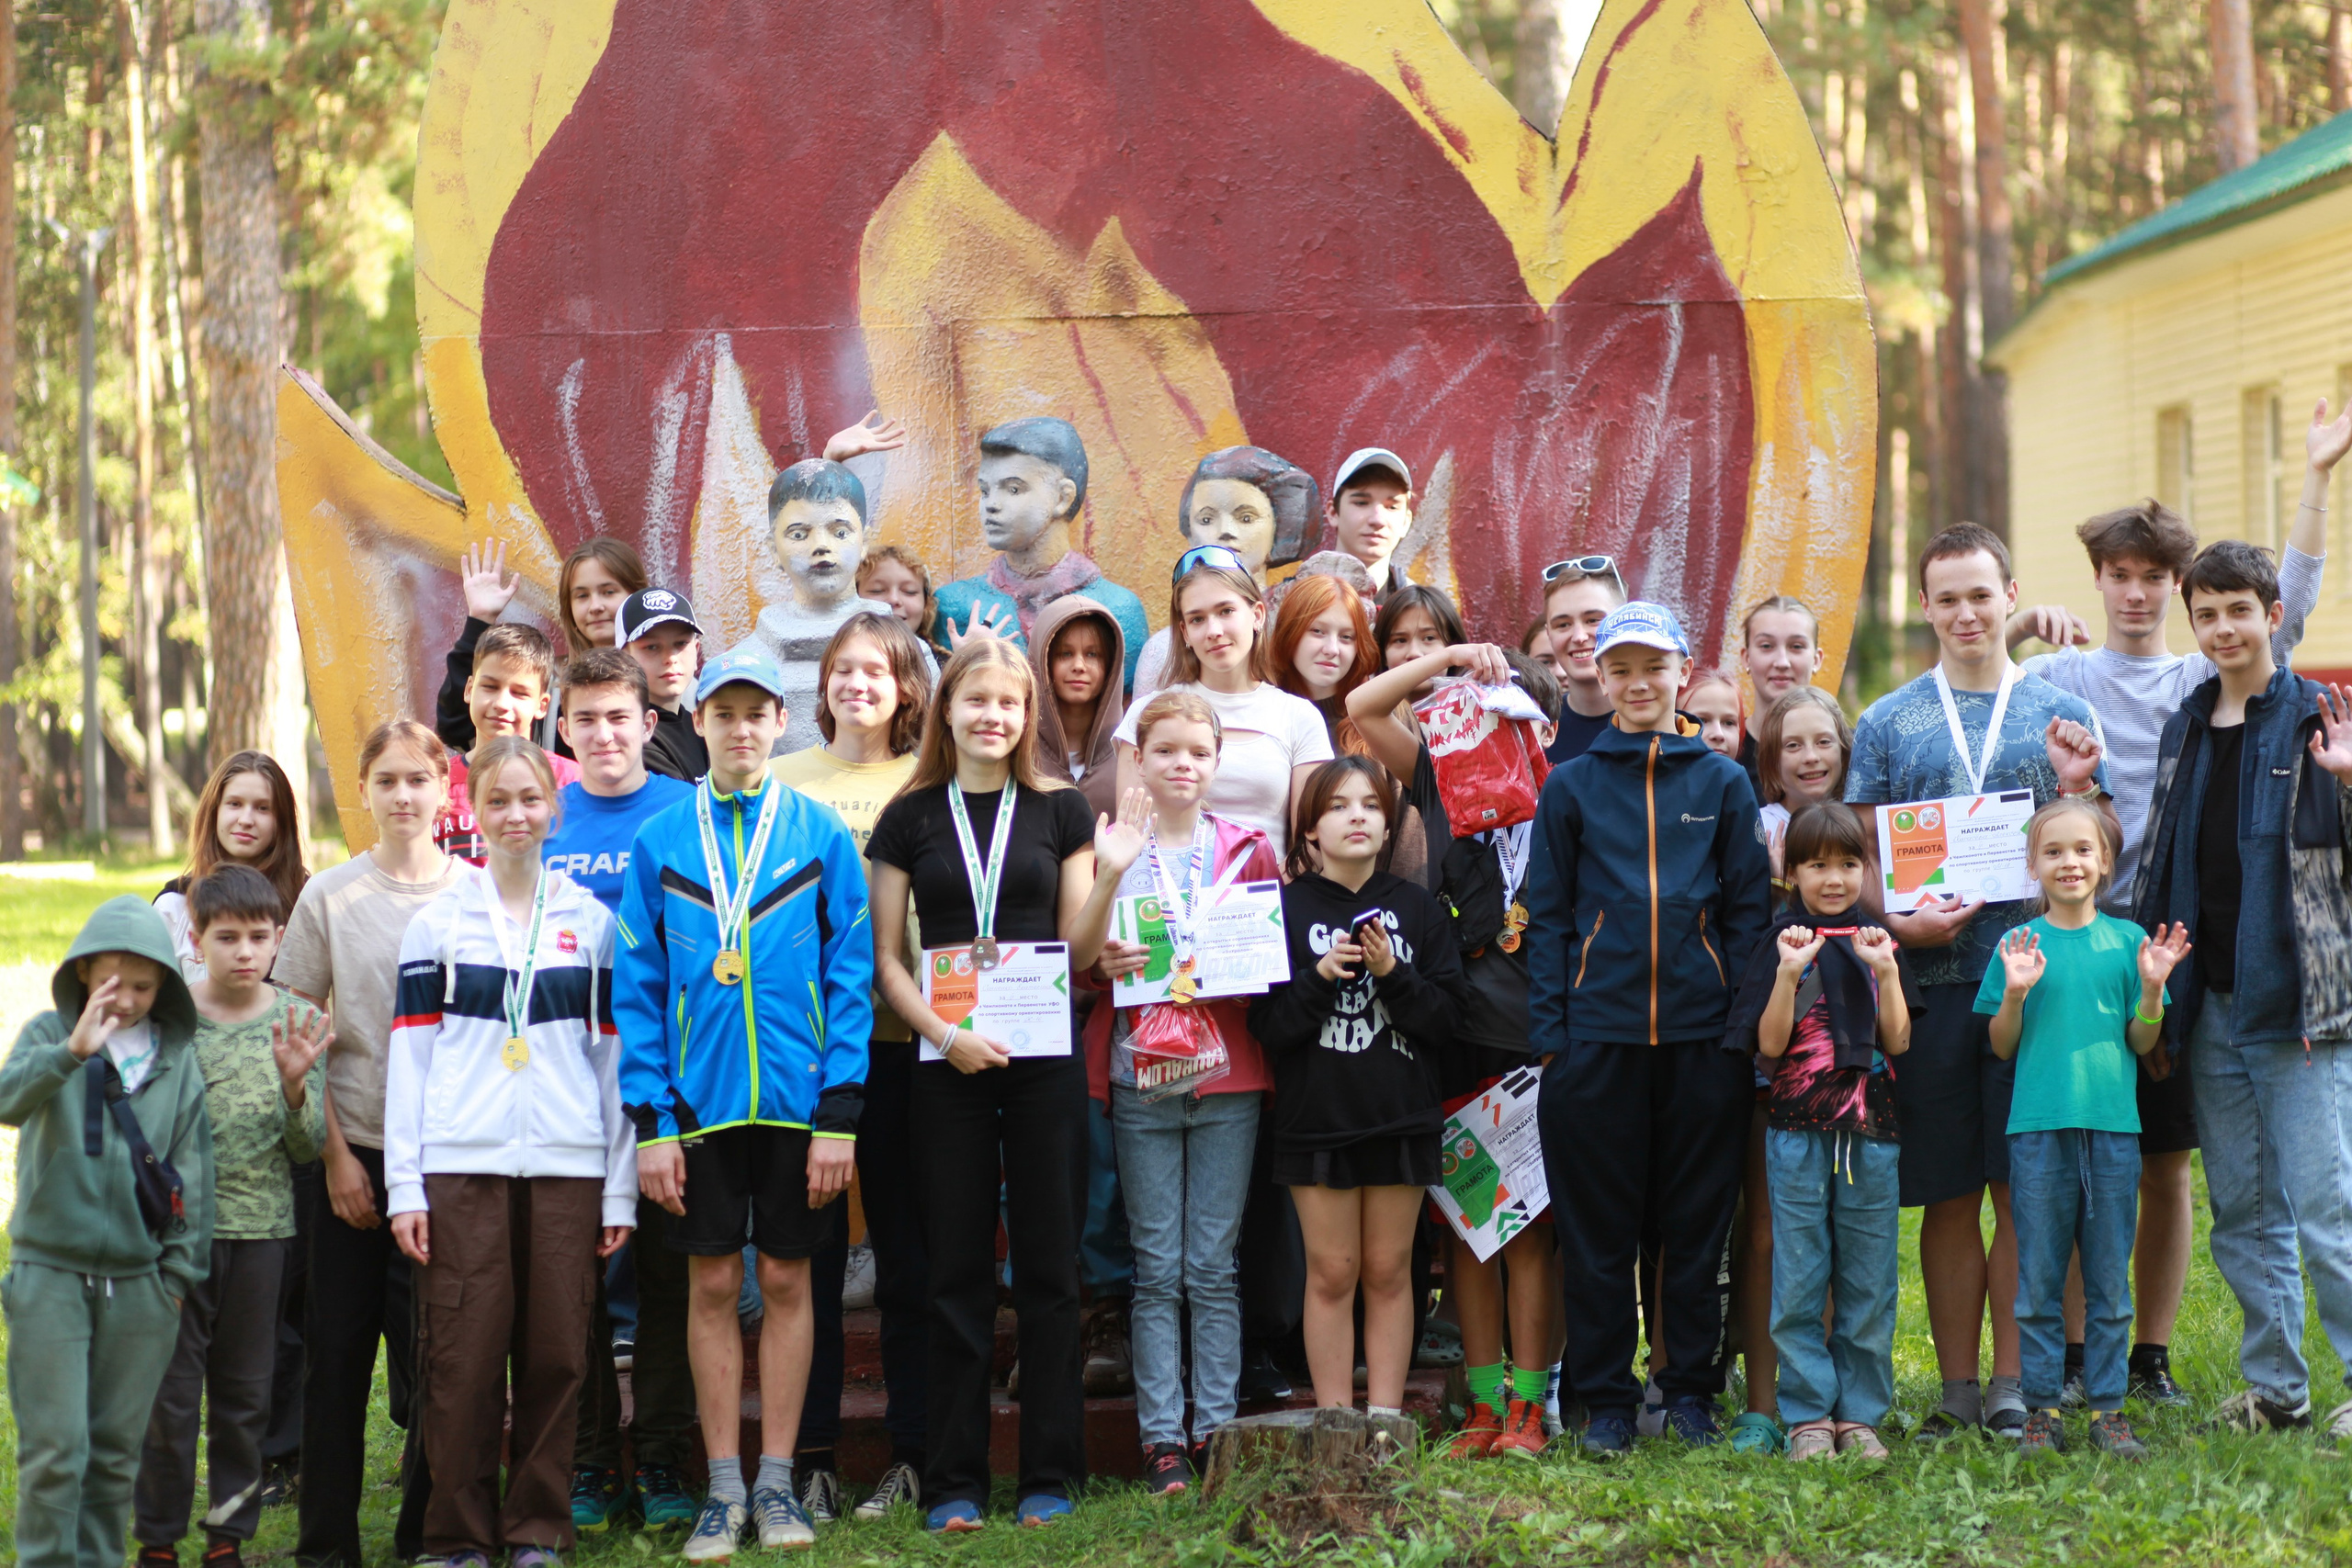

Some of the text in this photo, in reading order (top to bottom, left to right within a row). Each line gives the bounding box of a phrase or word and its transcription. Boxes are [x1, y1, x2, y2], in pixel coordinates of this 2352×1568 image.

[1608, 612, 1662, 626] ЧЕЛЯБИНСК
[1962, 824, 2008, 834] НАГРАЖДАЕТ
[1896, 844, 1944, 856] ГРАМОТА
[1208, 913, 1256, 921] НАГРАЖДАЕТ
[934, 991, 974, 1002] ГРАМОТА
[1498, 1113, 1535, 1145] НАГРАЖДАЕТ
[1455, 1164, 1495, 1197] ГРАМОТА
